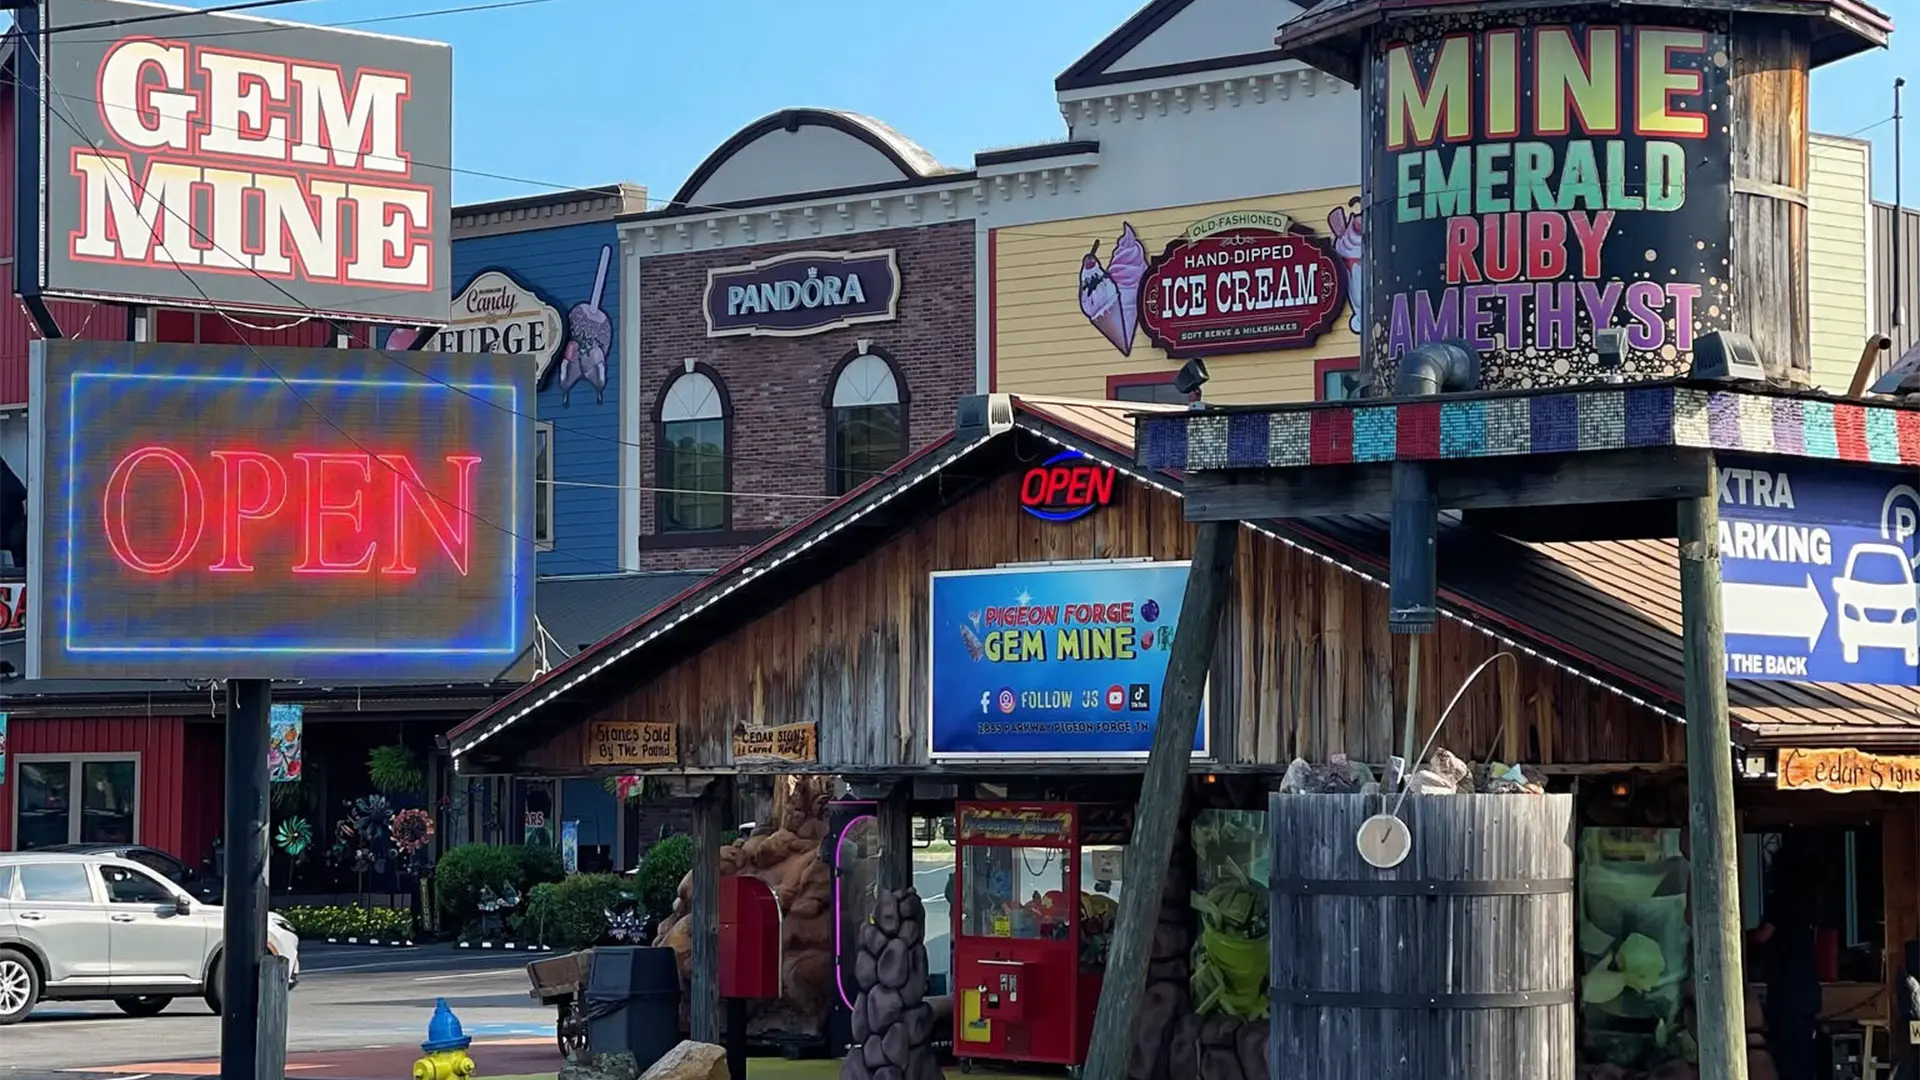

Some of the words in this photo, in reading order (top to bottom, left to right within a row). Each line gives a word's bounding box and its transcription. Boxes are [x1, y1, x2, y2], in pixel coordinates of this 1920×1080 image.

[97, 35, 411, 178] GEM
[1386, 25, 1709, 152] MINE
[1397, 140, 1687, 223] EMERALD
[70, 147, 433, 290] MINE
[1446, 211, 1615, 284] RUBY
[466, 285, 516, 316] Candy
[728, 272, 866, 316] PANDORA
[1162, 274, 1207, 318] ICE
[1216, 263, 1318, 313] CREAM
[438, 320, 546, 354] FUDGE
[1181, 331, 1203, 340] SOFT
[1205, 328, 1232, 338] SERVE
[1243, 322, 1297, 335] MILKSHAKES
[1388, 281, 1702, 360] AMETHYST
[1020, 465, 1116, 505] OPEN
[1717, 467, 1795, 509] XTRA
[103, 446, 482, 576] OPEN
[1718, 520, 1832, 565] ARKING
[985, 605, 1059, 627] PIGEON
[1064, 602, 1135, 625] FORGE
[984, 629, 1047, 662] GEM
[1057, 626, 1136, 661] MINE
[1731, 653, 1763, 674] THE
[1765, 655, 1808, 676] BACK
[1021, 690, 1073, 709] FOLLOW
[1082, 690, 1099, 708] US
[597, 724, 639, 742] Stones
[643, 724, 671, 742] Sold
[743, 731, 774, 744] CEDAR
[778, 728, 806, 743] SIGNS
[1004, 722, 1051, 734] PARKWAY
[1054, 721, 1093, 734] PIGEON
[600, 744, 614, 762] By
[618, 743, 638, 757] The
[643, 744, 670, 757] Pound
[1785, 748, 1864, 788] Cedar
[1869, 758, 1920, 790] Signs
